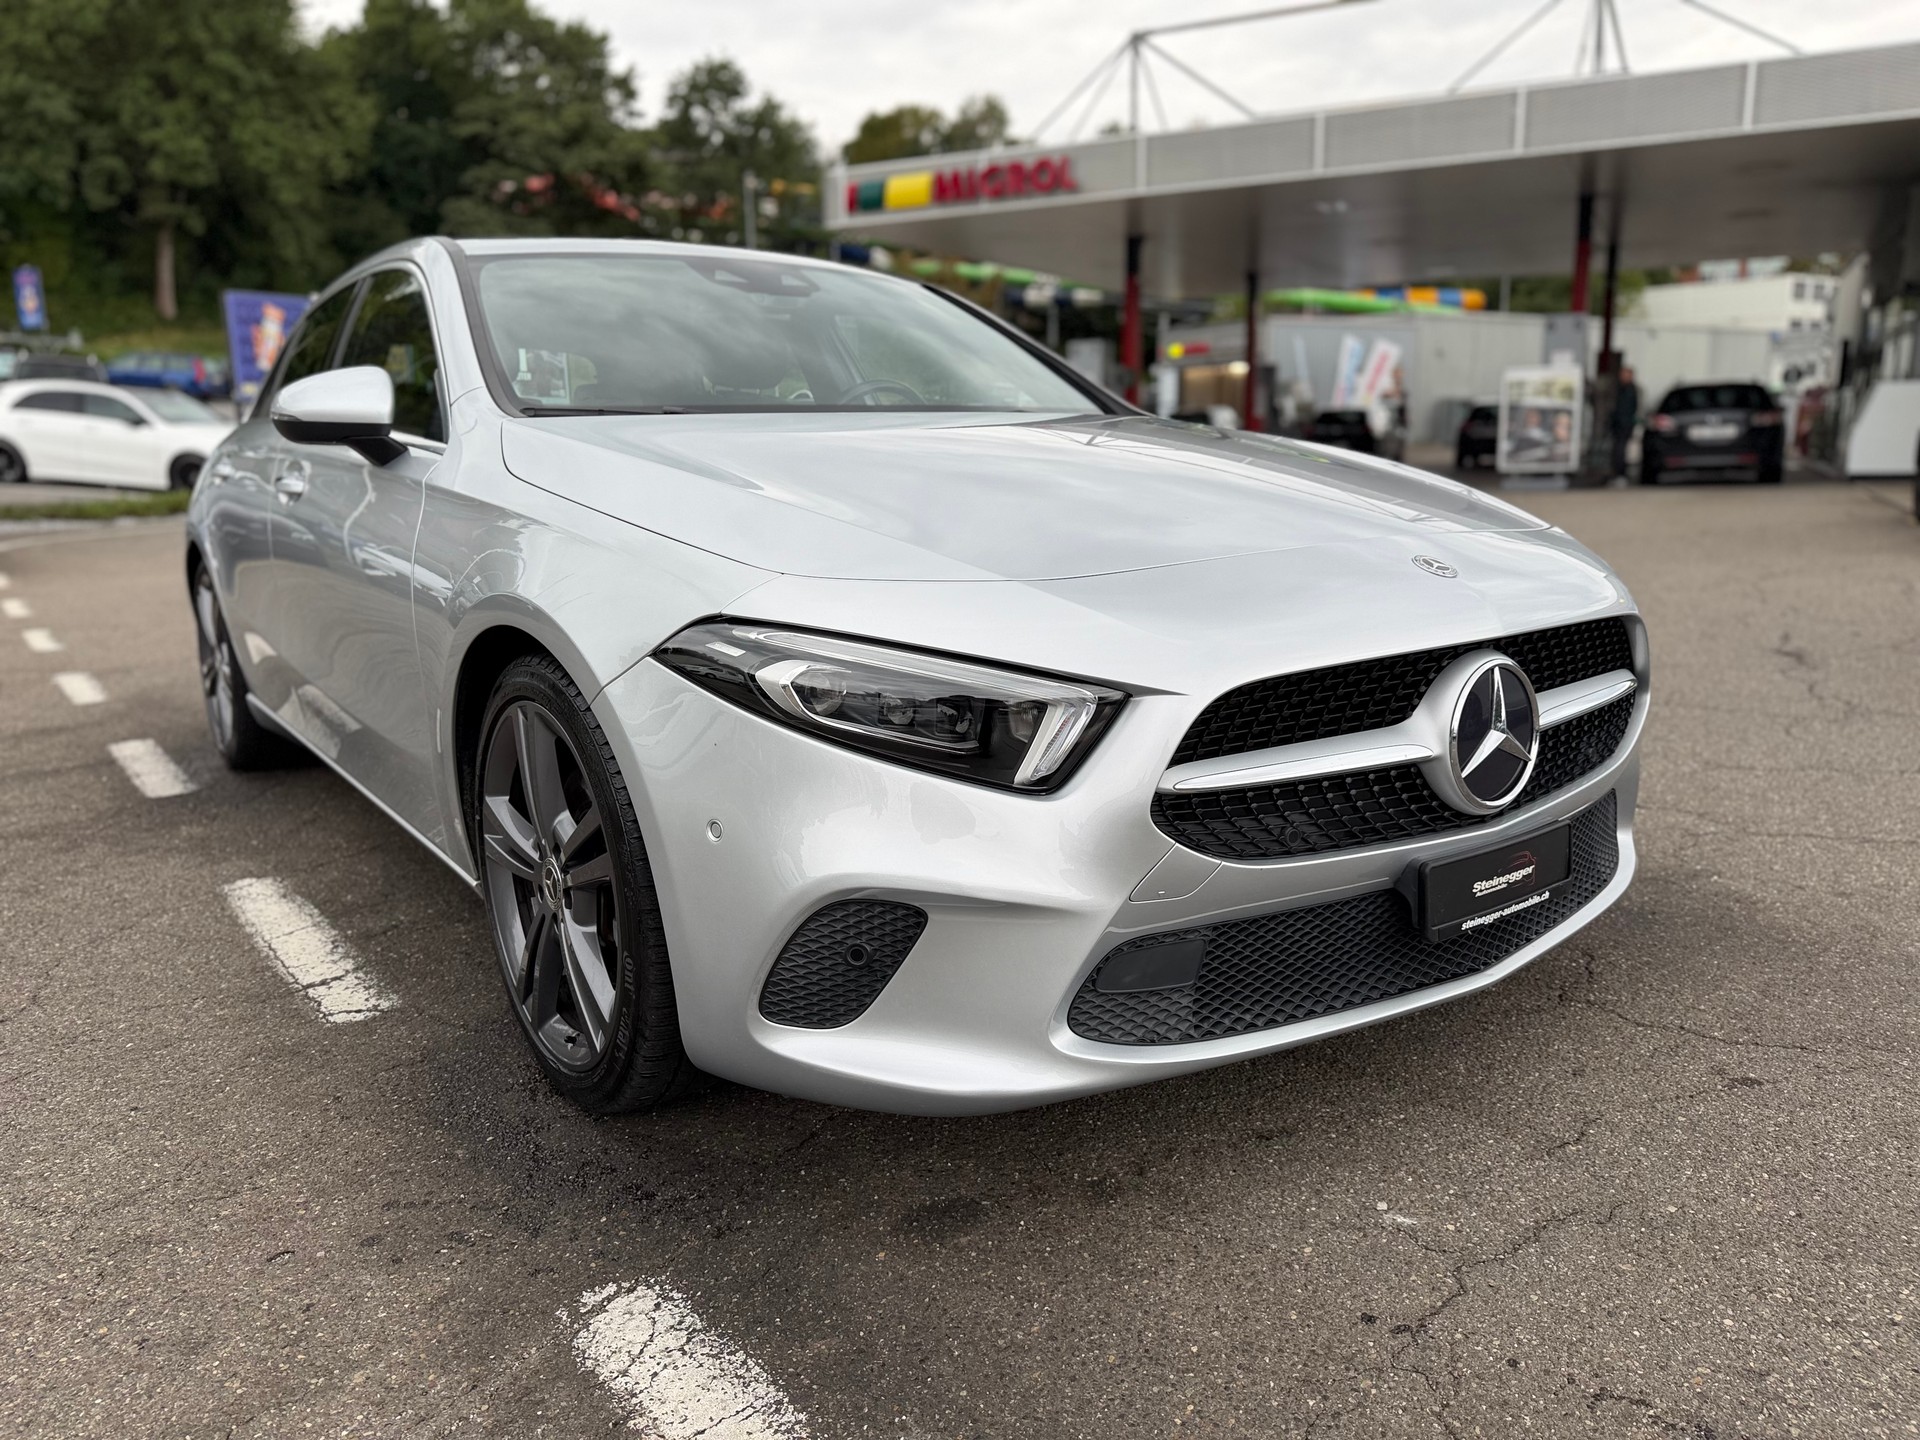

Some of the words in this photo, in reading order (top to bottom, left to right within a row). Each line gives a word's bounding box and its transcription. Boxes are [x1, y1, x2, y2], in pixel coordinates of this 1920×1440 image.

[934, 156, 1077, 203] MIGROL
[1472, 864, 1535, 892] Steinegger
[1461, 890, 1549, 930] steinegger-automobile.ch
